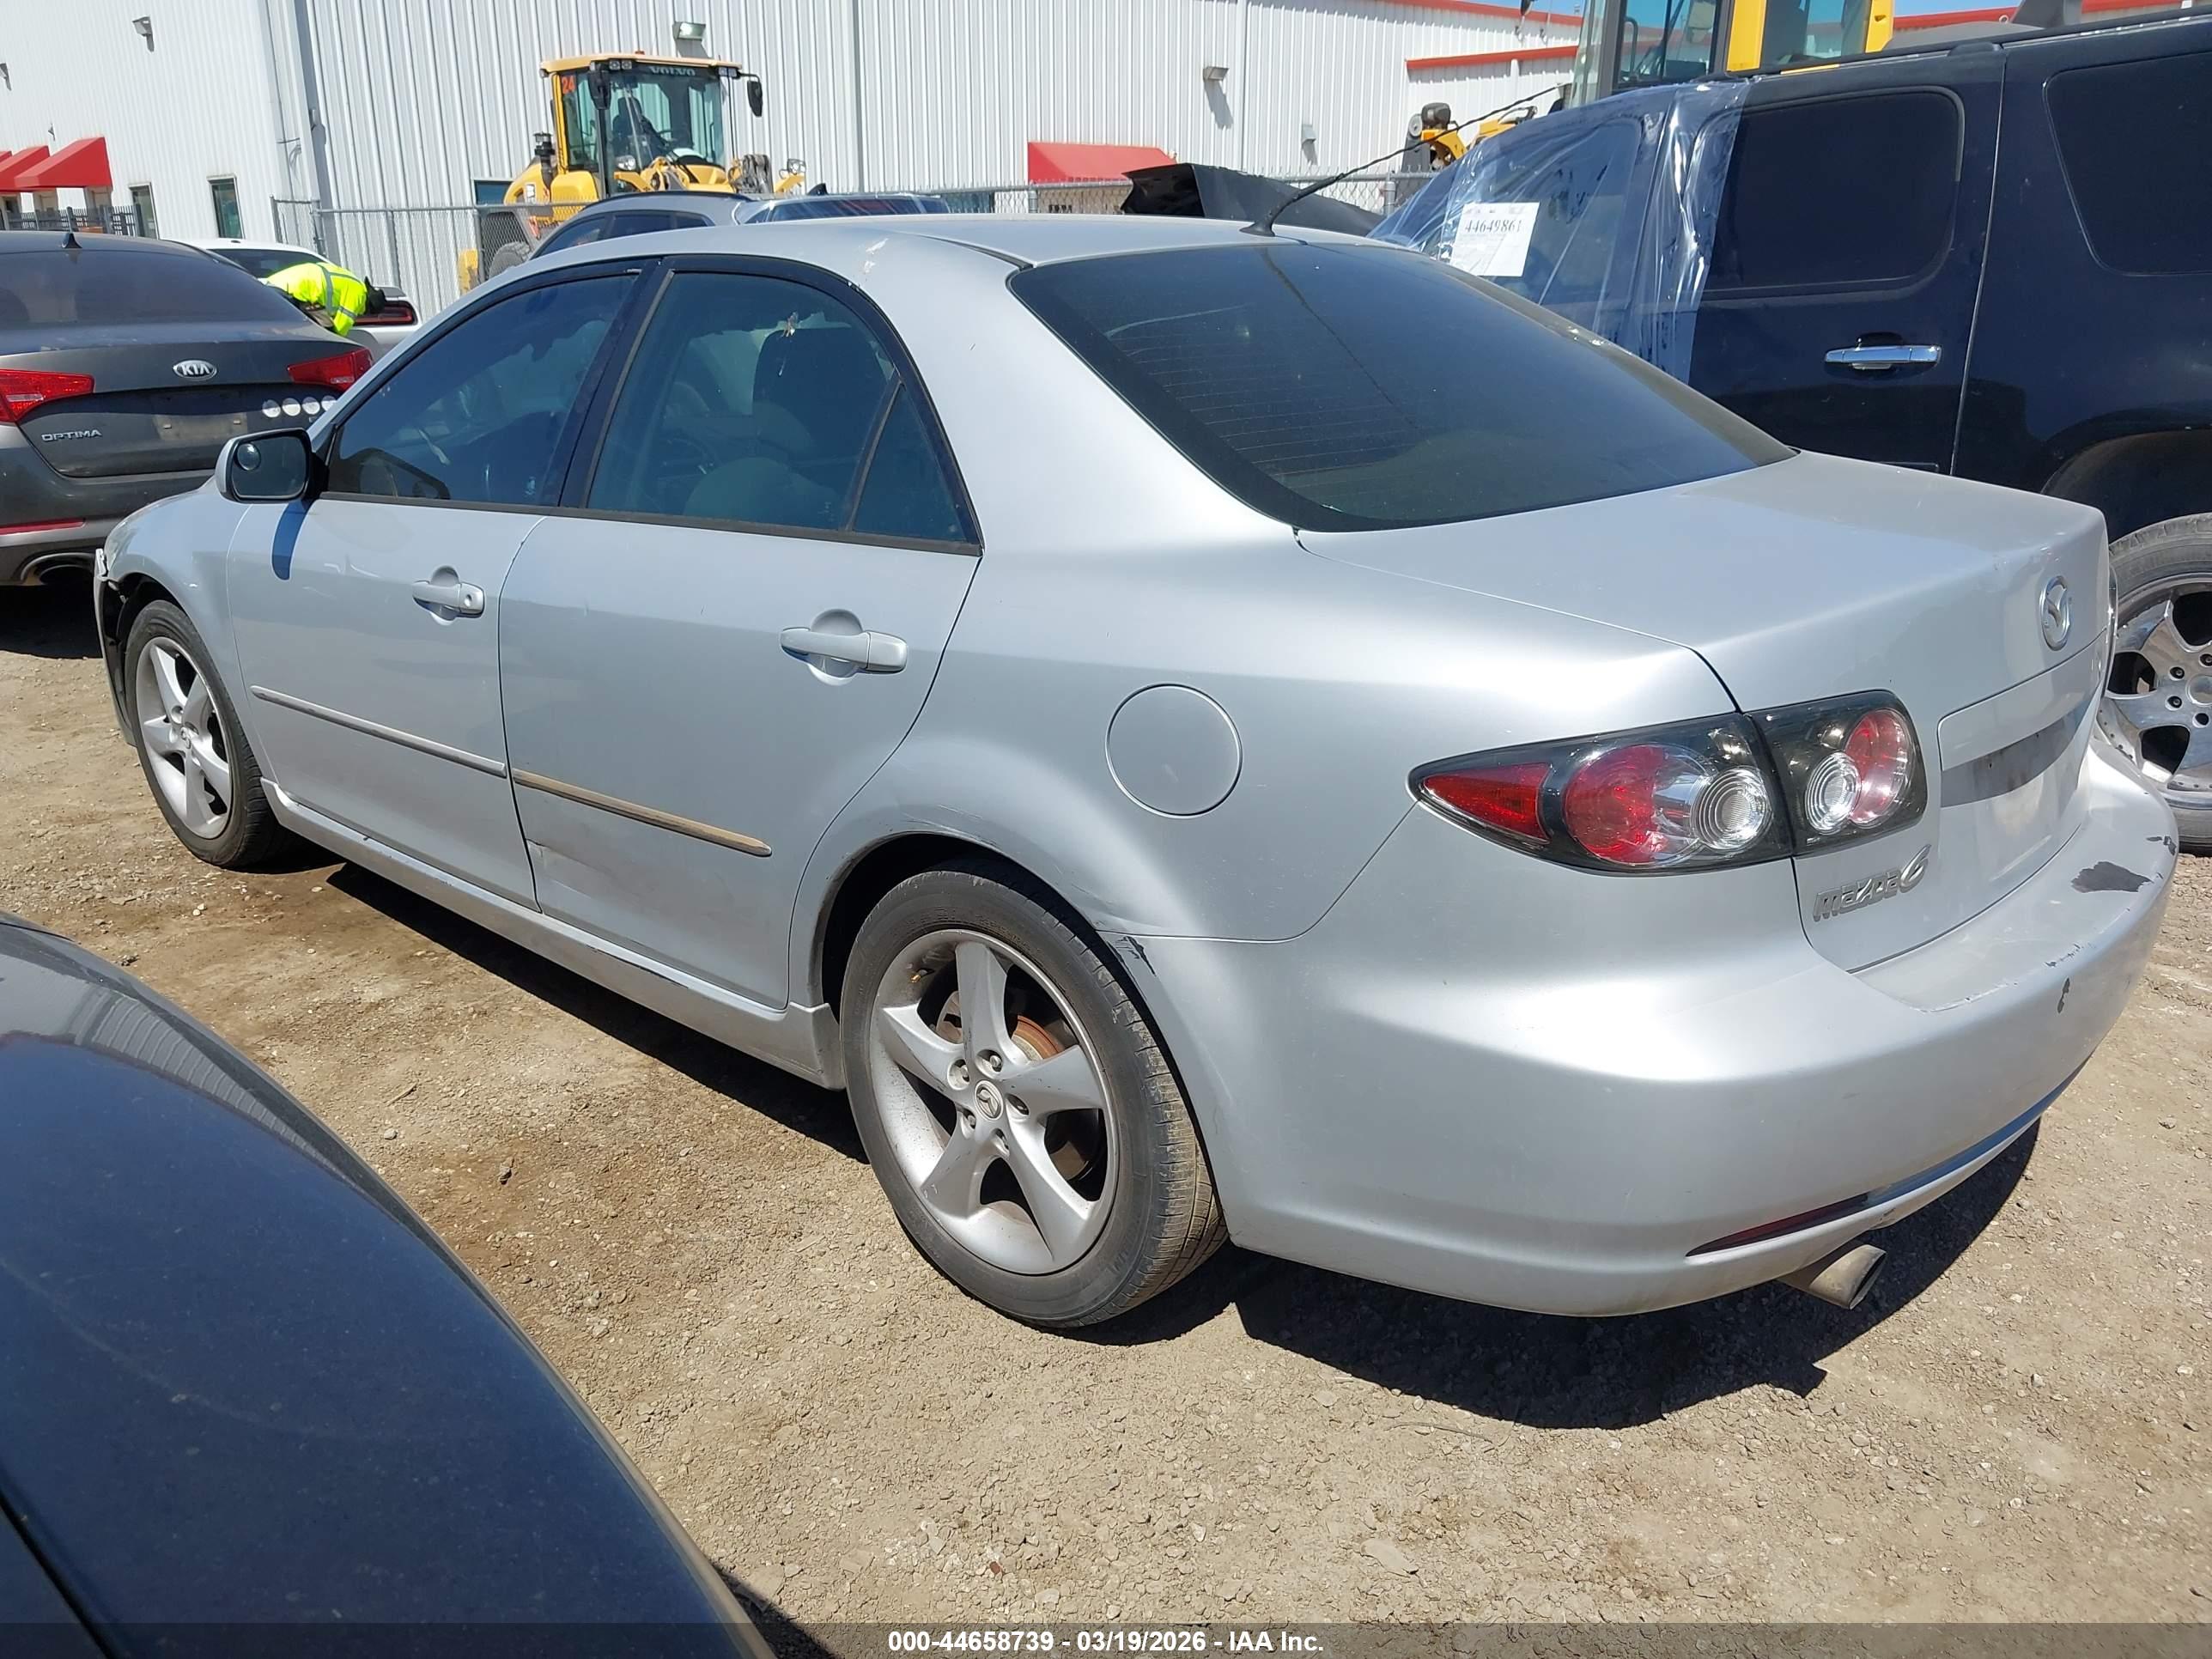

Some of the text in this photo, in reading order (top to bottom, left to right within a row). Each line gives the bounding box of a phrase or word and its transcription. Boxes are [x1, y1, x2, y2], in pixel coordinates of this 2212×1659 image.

[649, 65, 696, 76] VOLVO
[1465, 219, 1522, 233] 44649861
[181, 363, 211, 376] KIA
[41, 429, 102, 441] OPTIMA
